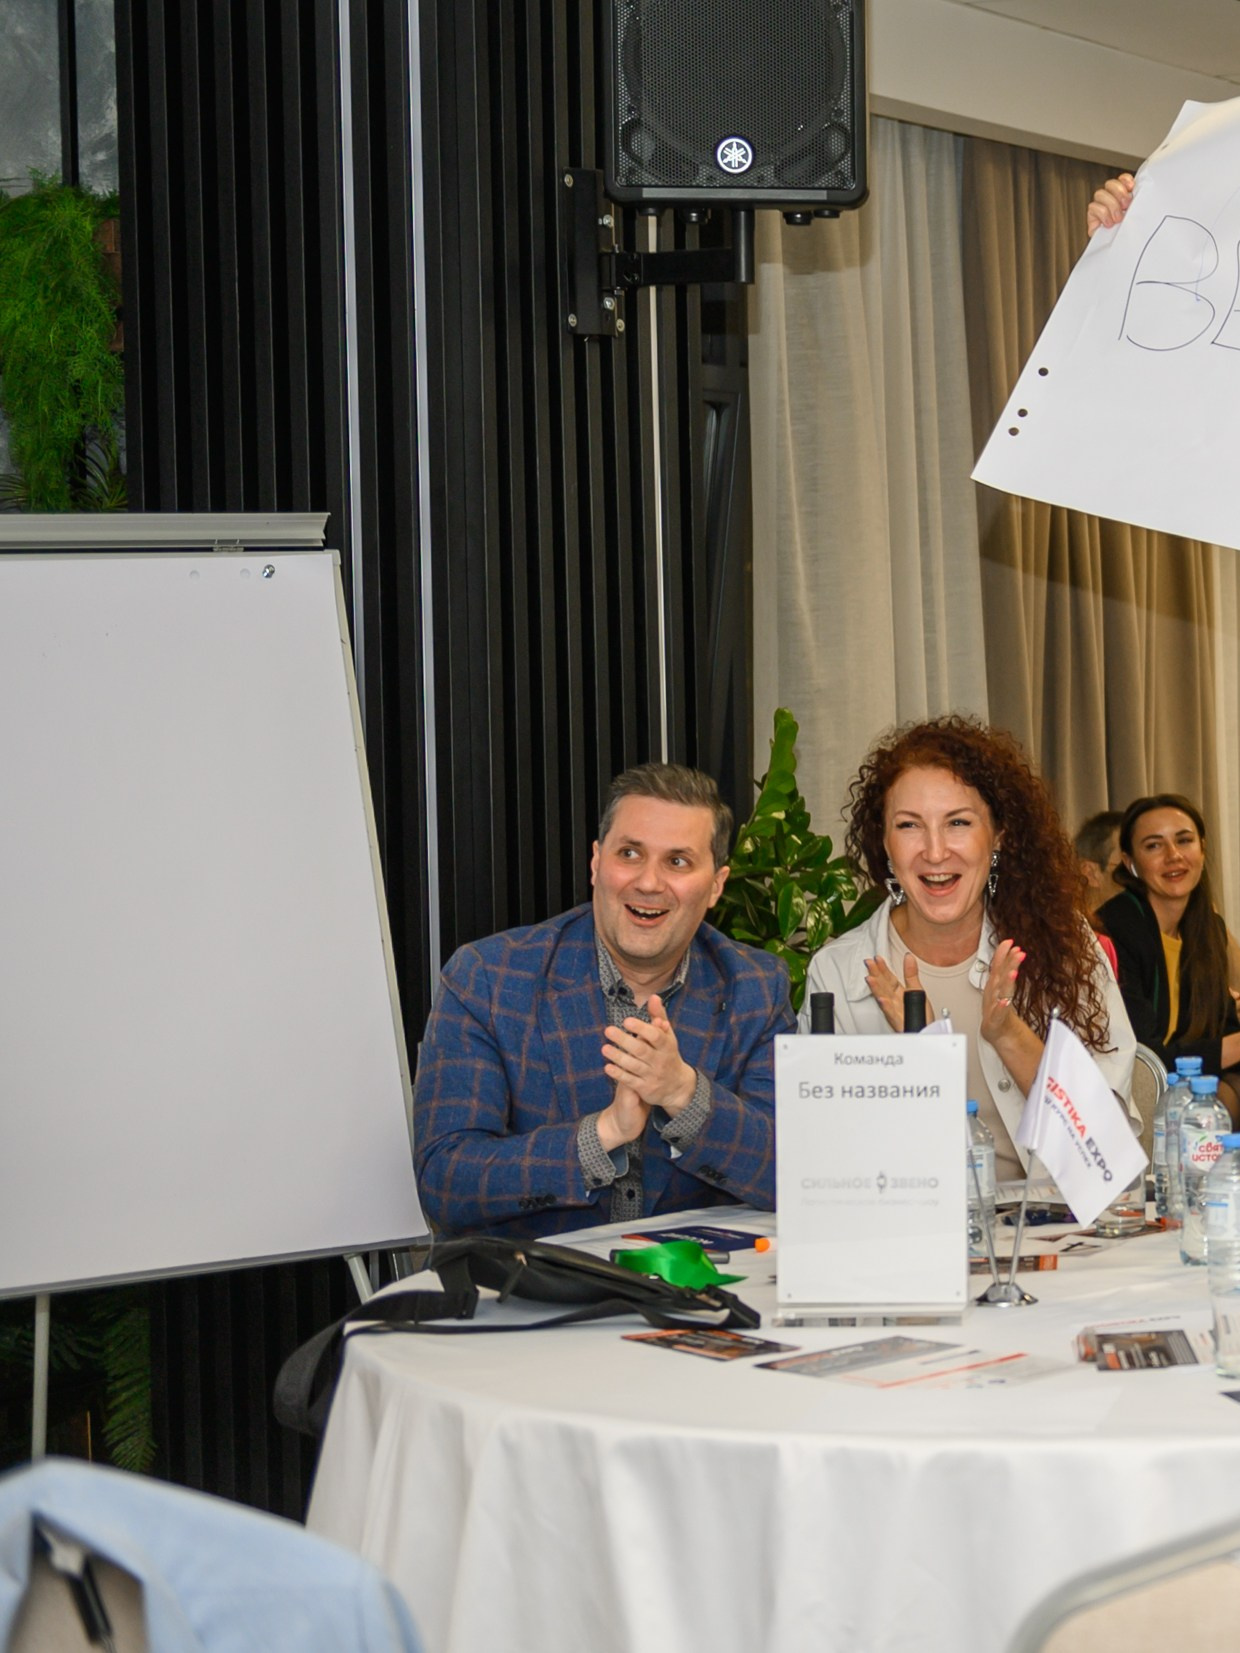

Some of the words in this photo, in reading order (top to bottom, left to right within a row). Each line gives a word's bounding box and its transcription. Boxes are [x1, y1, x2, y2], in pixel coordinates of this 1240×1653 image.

[833, 1052, 904, 1067] Команда
[798, 1081, 835, 1099] Без
[841, 1084, 941, 1099] названия
[1085, 1136, 1113, 1182] EXPO
[801, 1177, 872, 1190] СИЛЬНОЕ
[890, 1177, 940, 1190] ЗВЕНО
